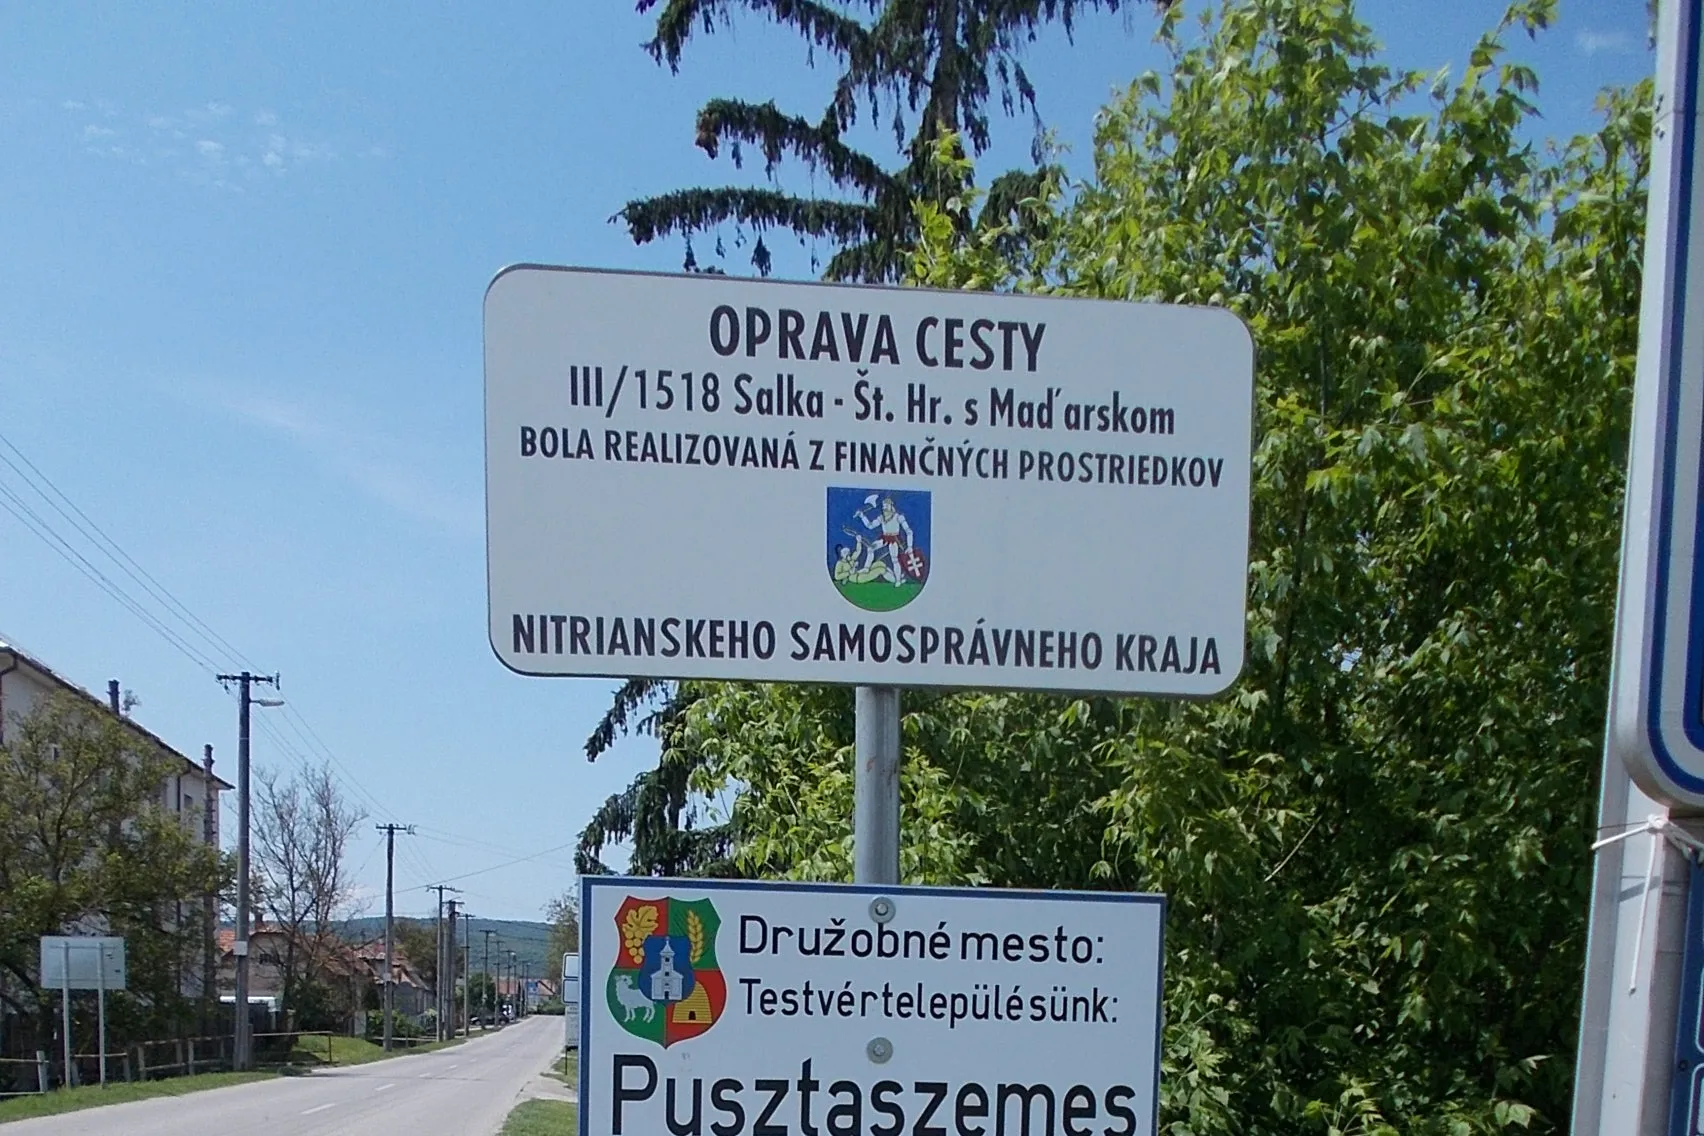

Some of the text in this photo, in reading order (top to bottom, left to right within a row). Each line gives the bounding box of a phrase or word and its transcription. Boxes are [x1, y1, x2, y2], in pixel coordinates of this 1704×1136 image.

[709, 304, 1046, 373] OPRAVA CESTY
[570, 365, 720, 415] III/1518
[733, 373, 824, 419] Salka
[834, 398, 844, 406] -
[854, 367, 895, 425] Št.
[907, 382, 953, 426] Hr.
[964, 398, 979, 426] s
[520, 425, 1224, 488] BOLA REALIZOVANÁ Z FINANČNÝCH PROSTRIEDKOV
[512, 613, 1222, 675] NITRIANSKEHO SAMOSPRÁVNEHO KRAJA
[739, 914, 1104, 964] Družobné mesto:
[738, 977, 1118, 1029] Testvértelepülésünk:
